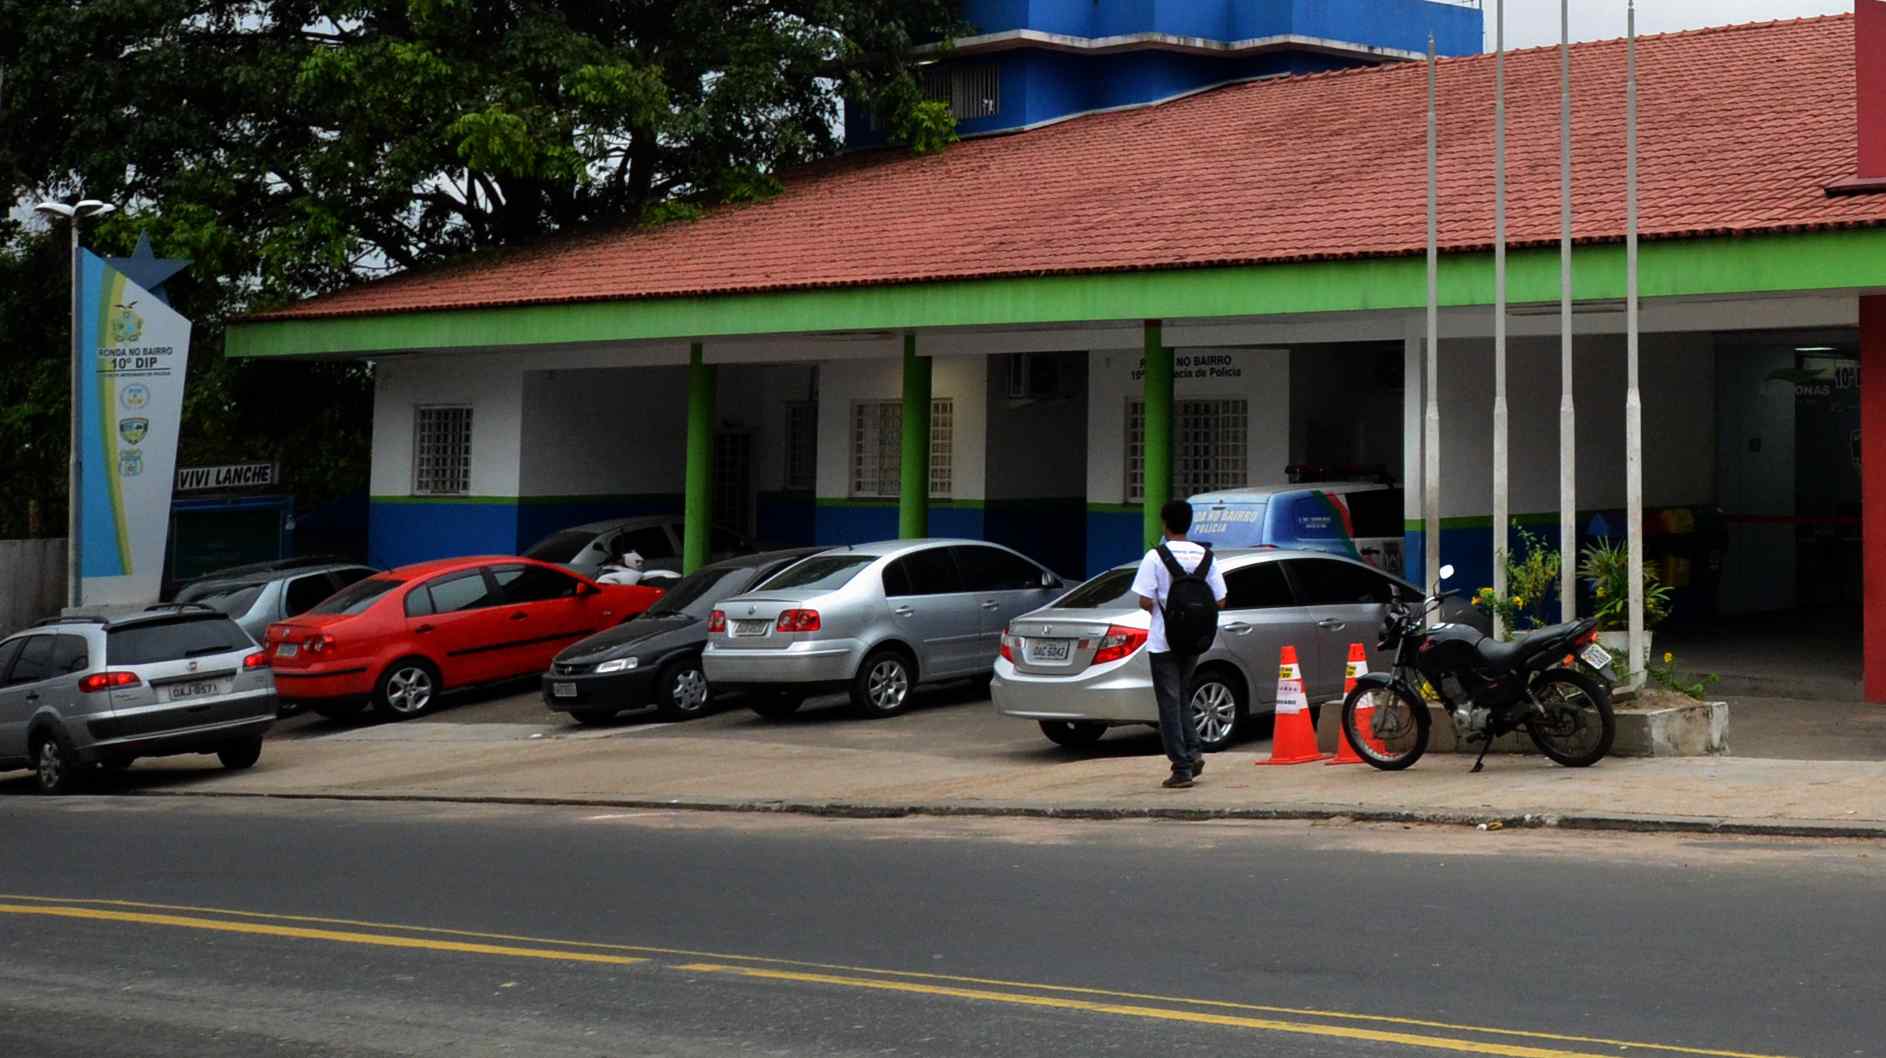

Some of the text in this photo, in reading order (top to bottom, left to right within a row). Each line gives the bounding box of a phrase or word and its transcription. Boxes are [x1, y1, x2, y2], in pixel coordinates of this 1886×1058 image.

[129, 347, 140, 356] NO
[143, 346, 173, 355] BAIRRO
[135, 357, 157, 368] DIP
[1176, 354, 1232, 367] NO BAIRRO
[1194, 368, 1206, 378] de
[180, 465, 270, 489] VIVI LANCHE
[1221, 511, 1258, 522] BAIRRO
